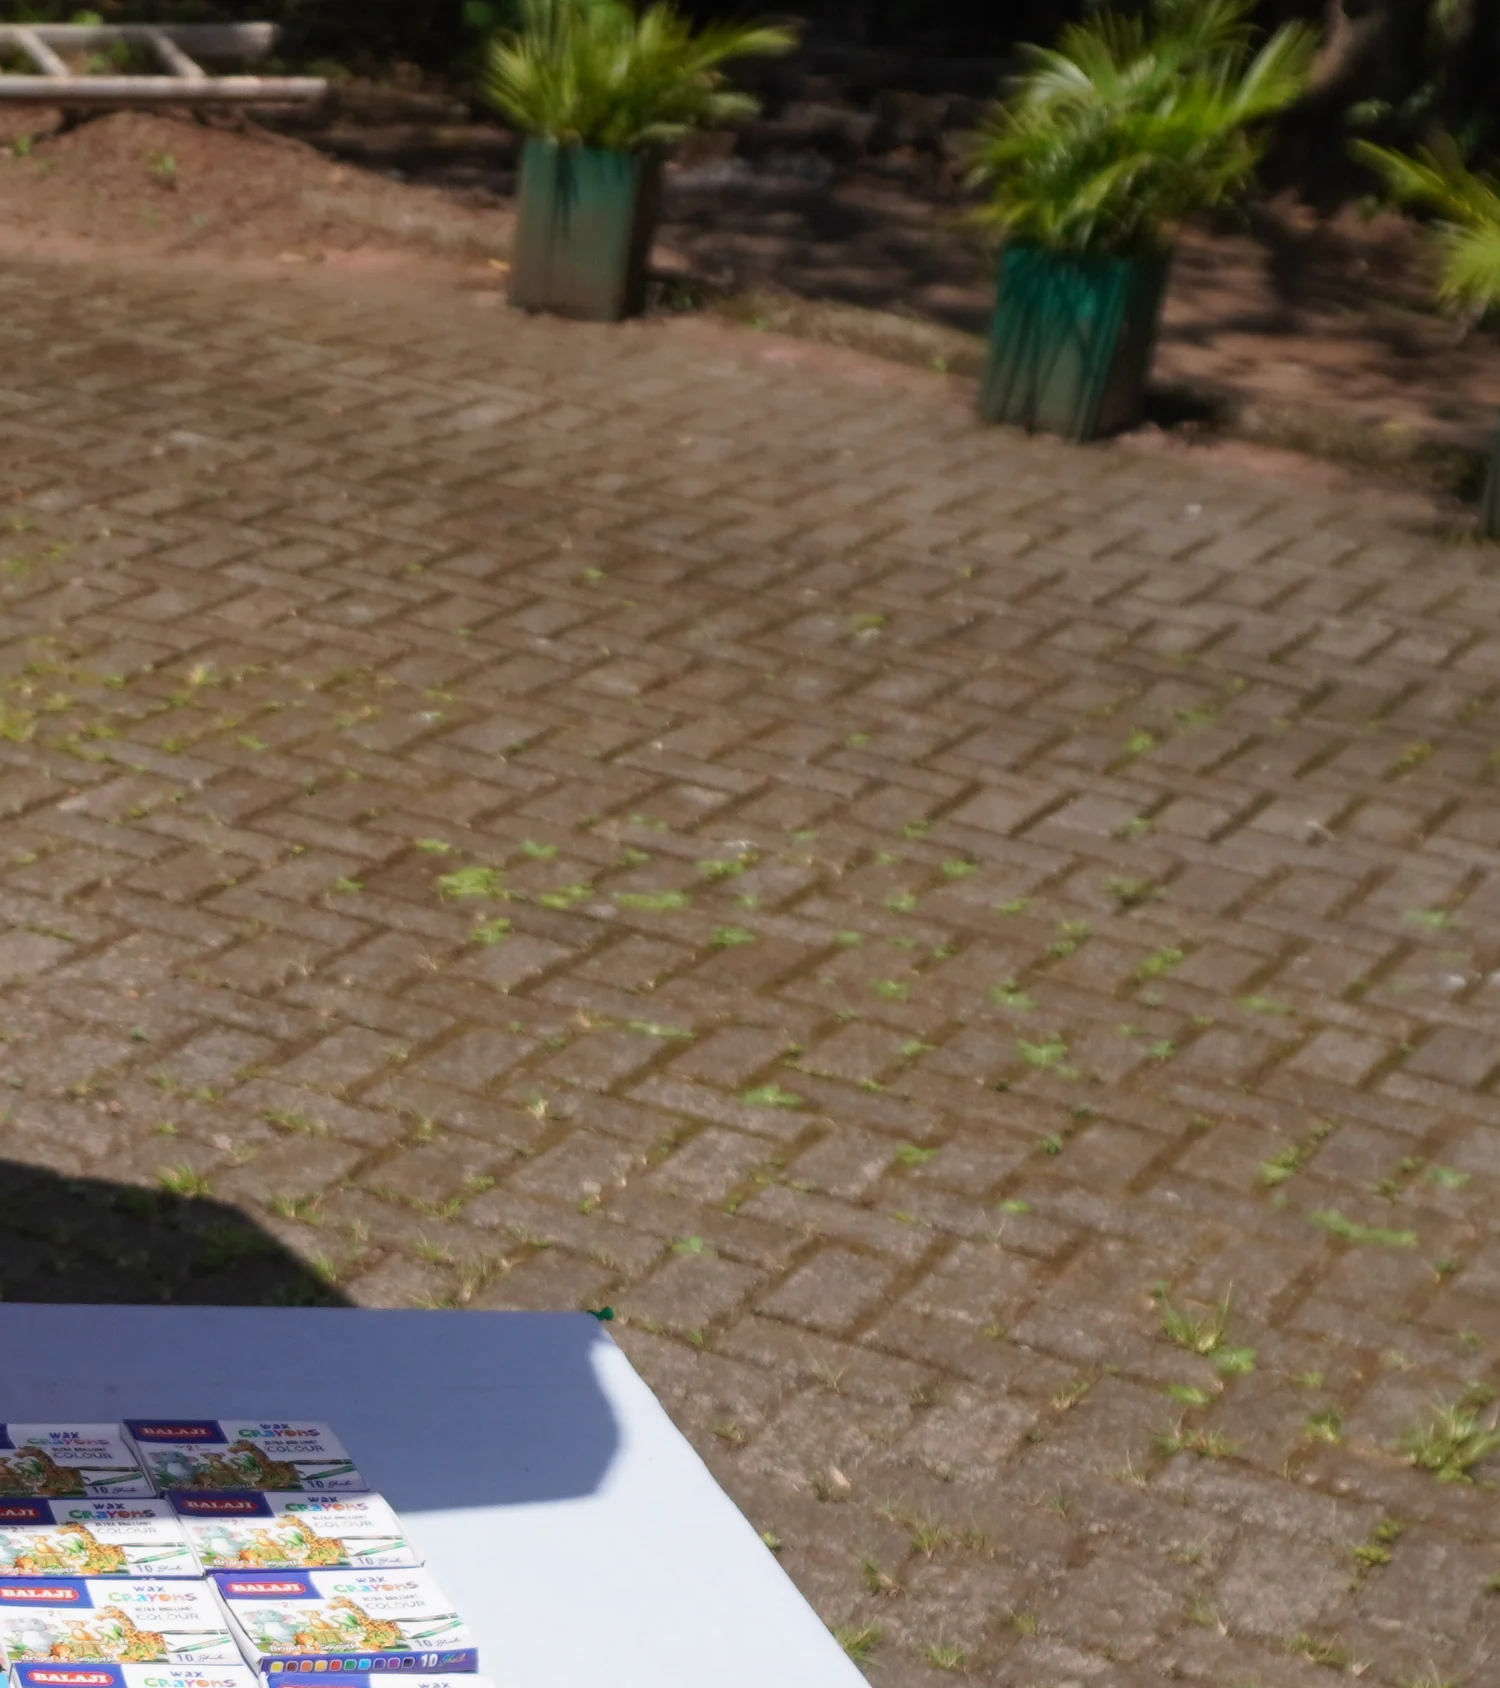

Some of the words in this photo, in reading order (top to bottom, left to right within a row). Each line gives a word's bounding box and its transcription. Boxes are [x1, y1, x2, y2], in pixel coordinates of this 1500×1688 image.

[141, 1428, 206, 1436] BALAJI
[187, 1500, 252, 1509] BALAJI
[232, 1583, 301, 1592] BALAJI
[1, 1589, 73, 1598] BALAJI
[420, 1653, 437, 1668] 10
[35, 1674, 108, 1683] BALAJI
